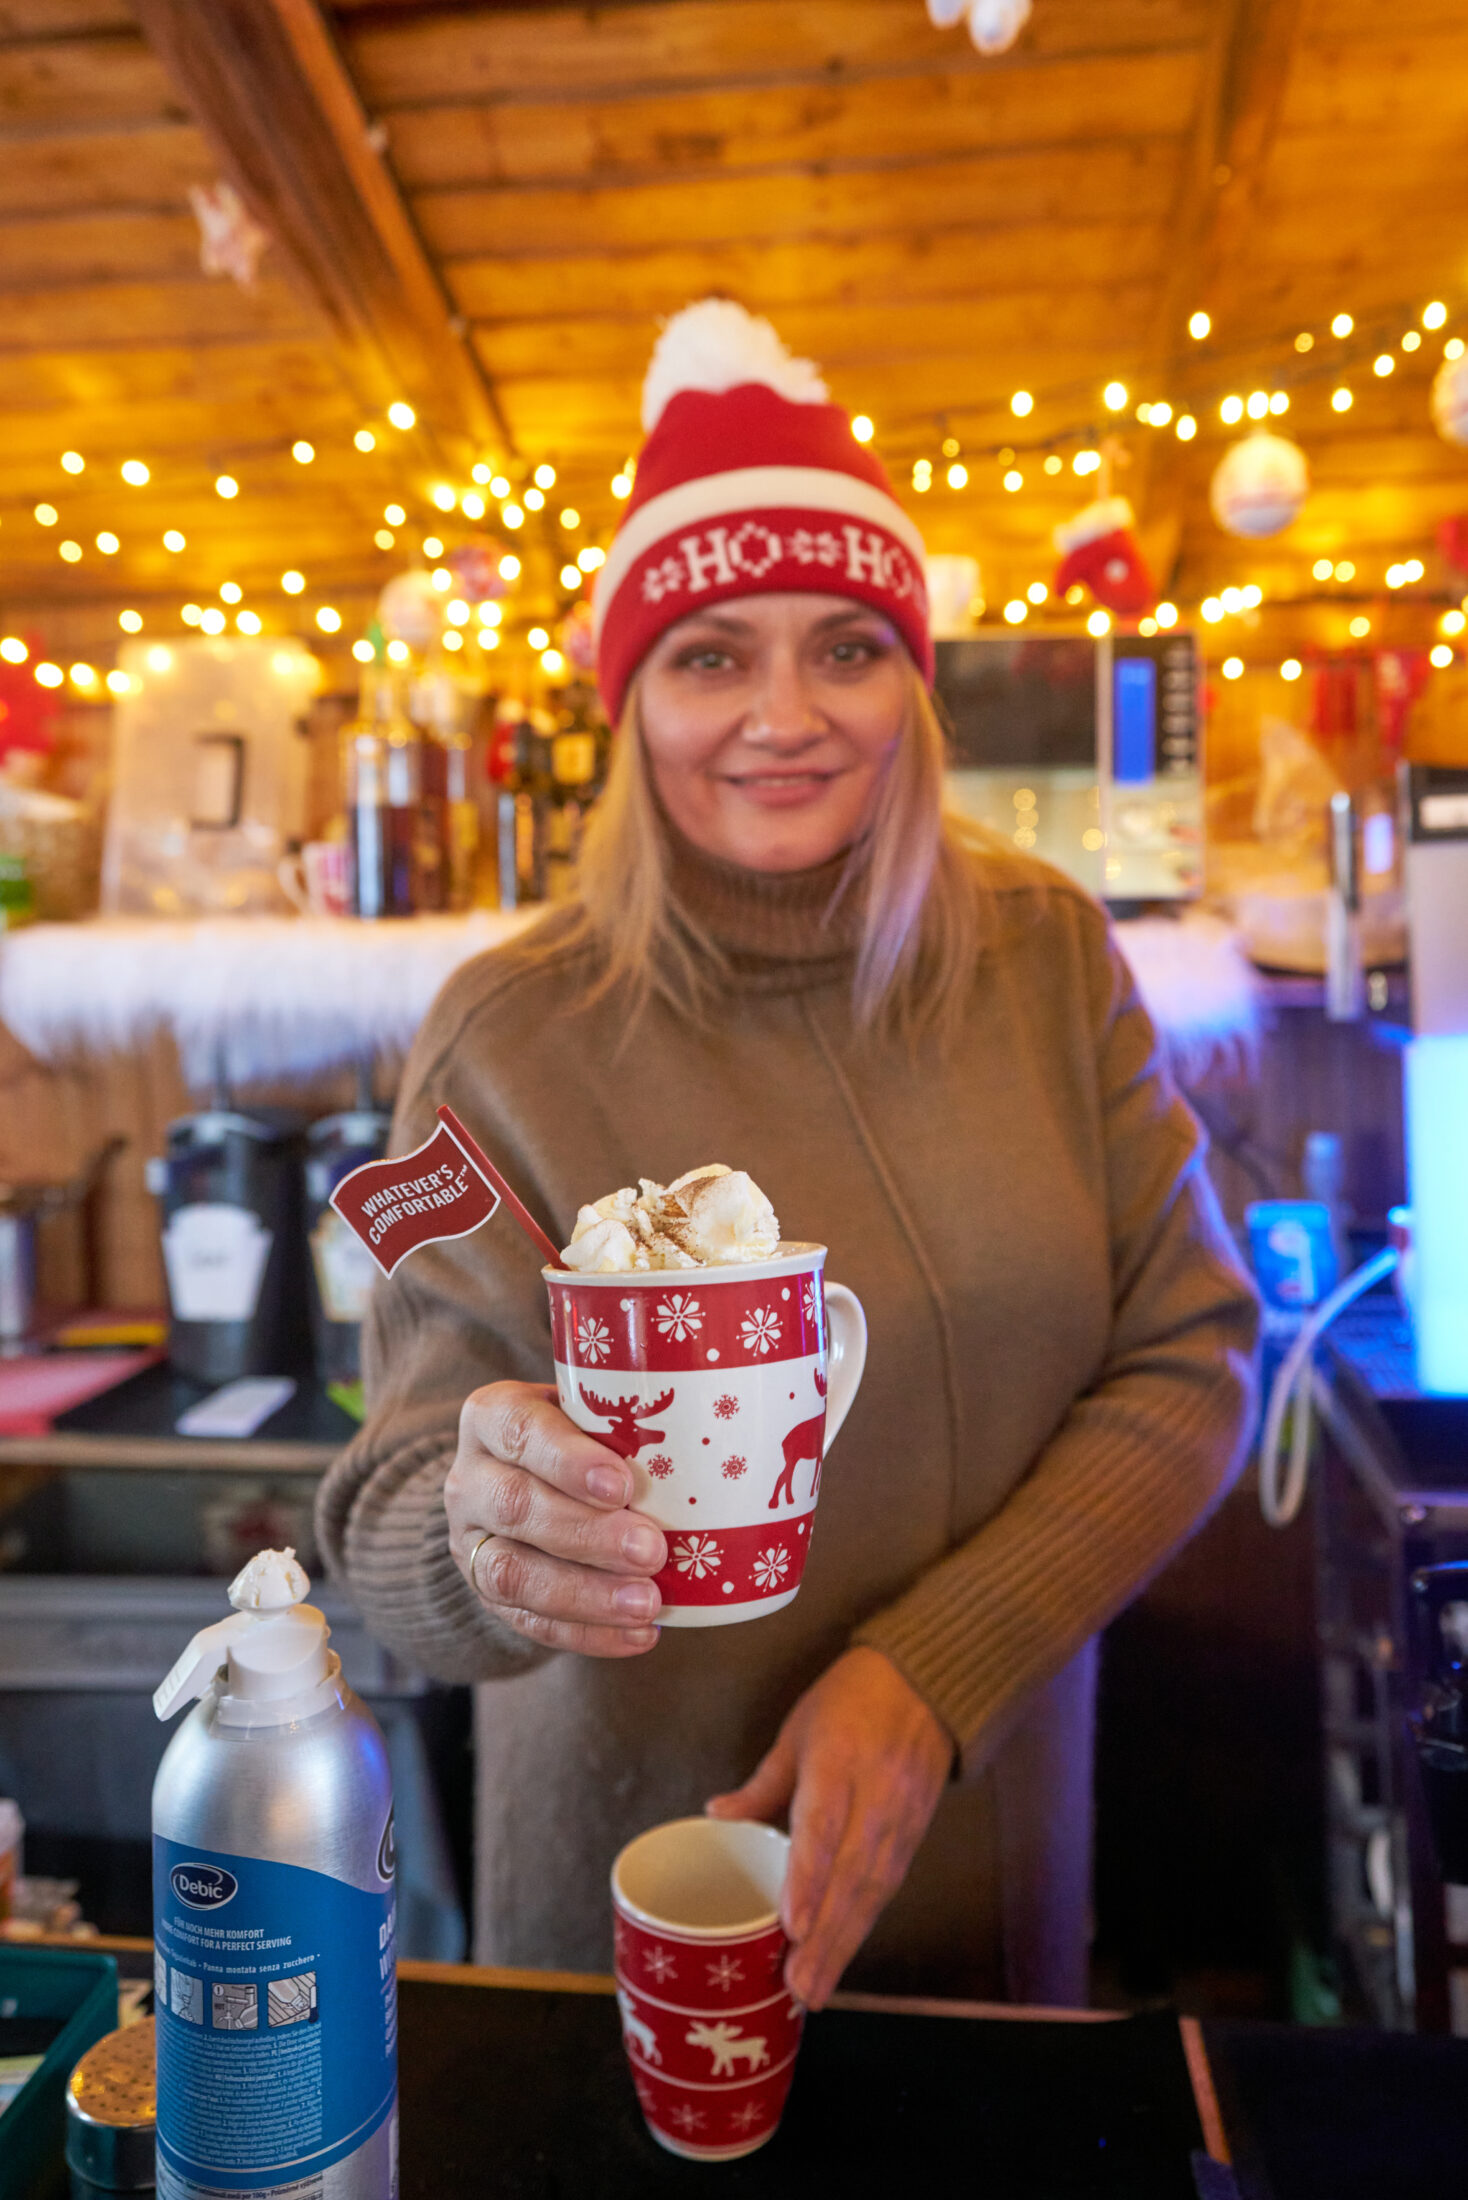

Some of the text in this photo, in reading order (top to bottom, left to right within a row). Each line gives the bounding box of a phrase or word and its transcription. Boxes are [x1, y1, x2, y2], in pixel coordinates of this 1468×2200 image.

[679, 521, 783, 593] HO
[361, 1163, 454, 1218] WHATEVER'S
[179, 1873, 223, 1899] Debic
[200, 1938, 214, 1949] FOR
[214, 1941, 221, 1950] A
[222, 1941, 255, 1951] PERFECT
[256, 1935, 292, 1950] SERVING
[204, 1927, 225, 1939] MEHR
[226, 1929, 265, 1940] KOMFORT
[259, 1964, 280, 1973] senza
[283, 1954, 315, 1969] zucchero
